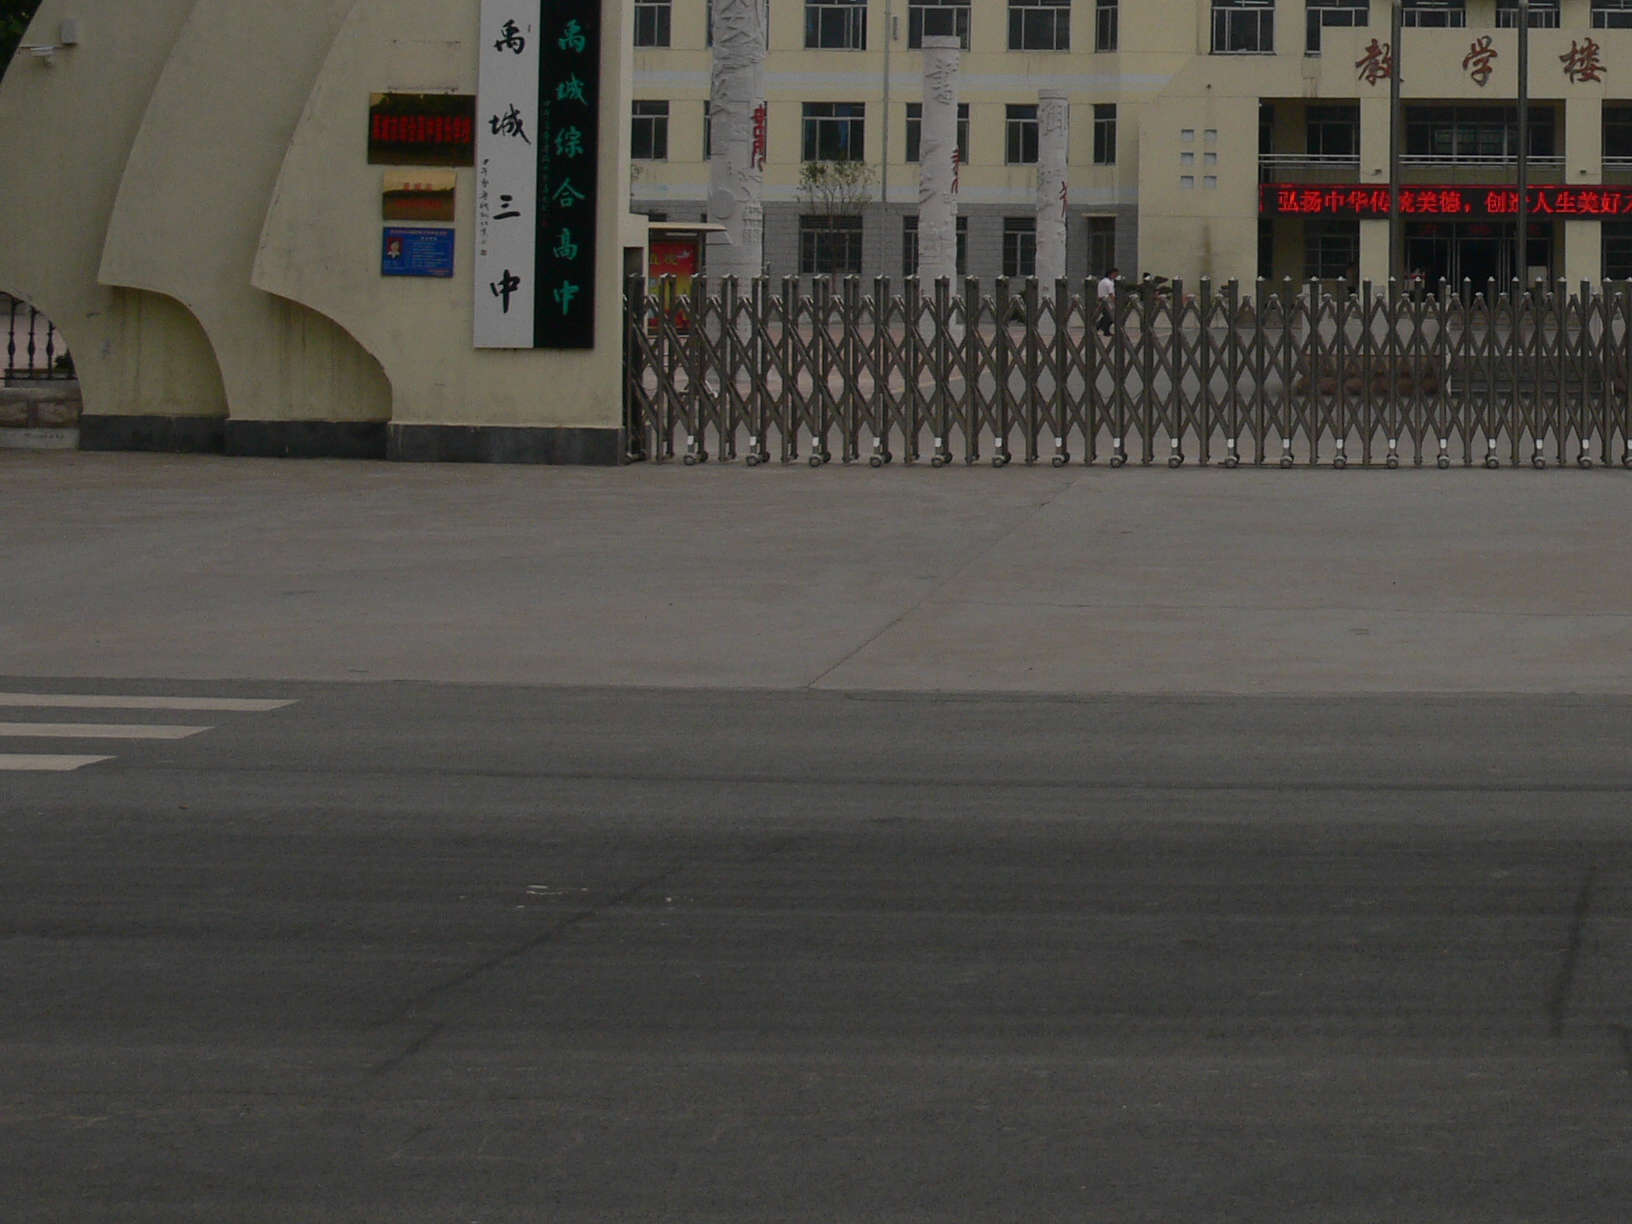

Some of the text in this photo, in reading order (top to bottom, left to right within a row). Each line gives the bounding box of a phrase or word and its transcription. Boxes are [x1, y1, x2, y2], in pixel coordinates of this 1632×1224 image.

[489, 19, 532, 315] 禹城三中
[551, 19, 589, 316] 禹城综合高中
[1355, 35, 1608, 87] 教学楼
